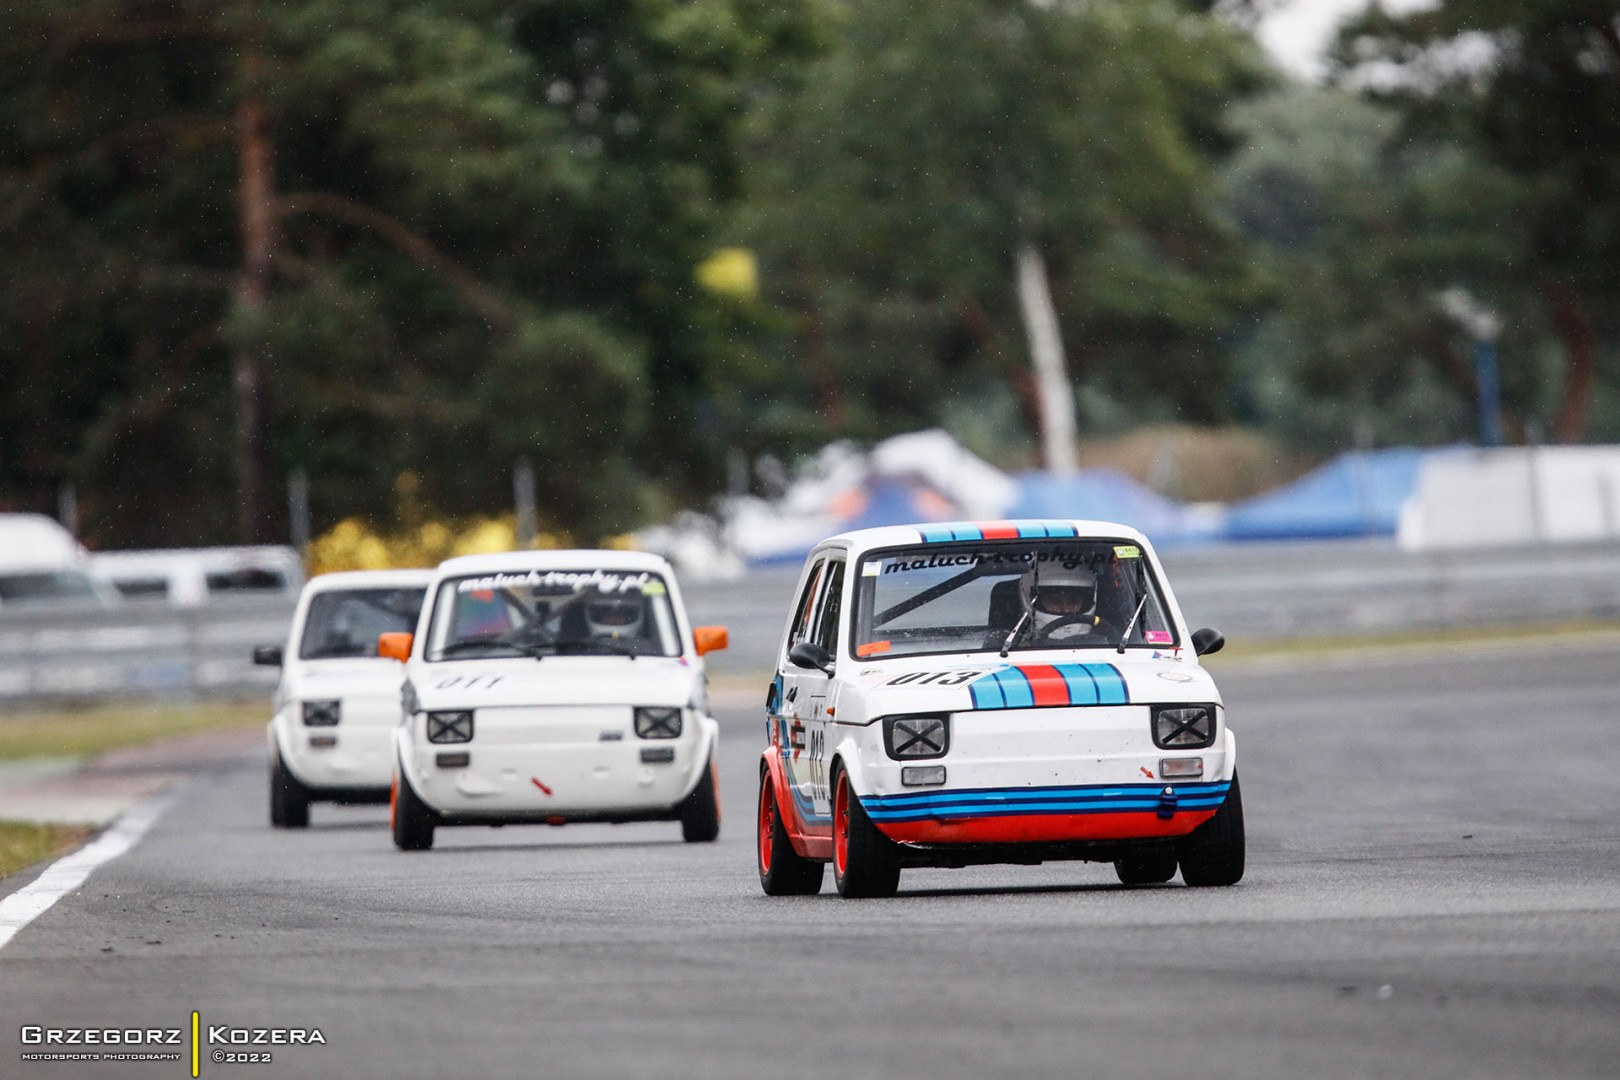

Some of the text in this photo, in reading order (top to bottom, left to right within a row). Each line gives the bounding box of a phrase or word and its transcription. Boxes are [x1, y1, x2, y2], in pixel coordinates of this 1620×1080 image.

[884, 546, 1117, 575] maluch-trophy.pl
[457, 568, 650, 593] maluch-trophy.pl
[886, 671, 982, 686] 013
